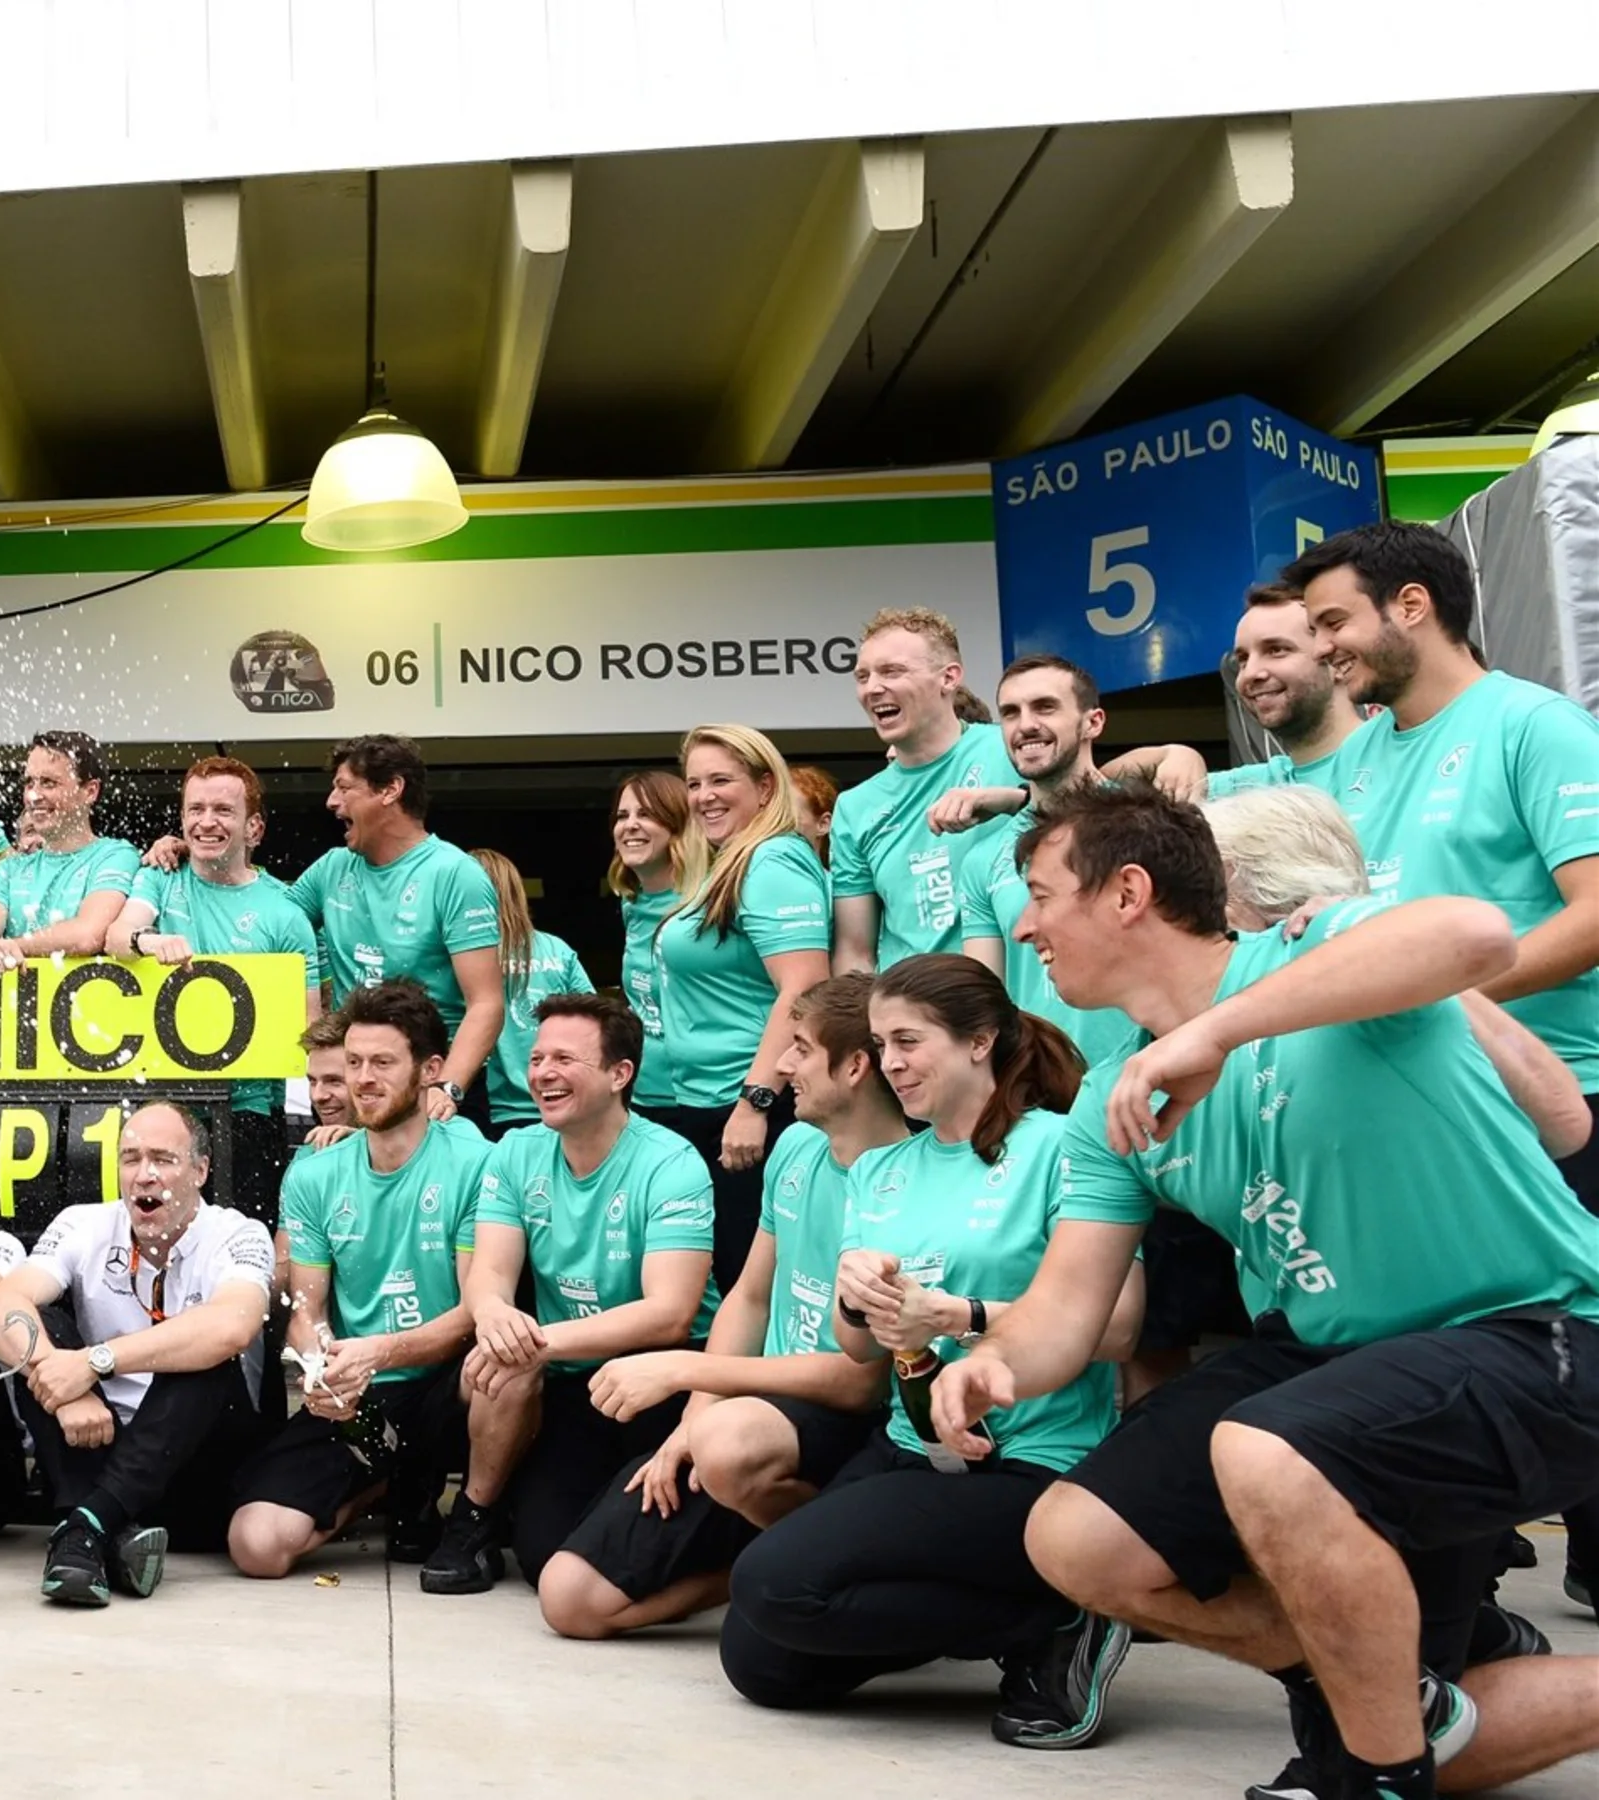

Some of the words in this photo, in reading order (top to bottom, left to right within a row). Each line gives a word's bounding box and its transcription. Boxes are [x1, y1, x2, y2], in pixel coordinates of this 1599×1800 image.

[1007, 461, 1079, 506] SÃO
[1104, 418, 1233, 480] PAULO
[1250, 415, 1288, 461] SÃO
[1299, 439, 1360, 491] PAULO
[1086, 525, 1157, 637] 5
[366, 650, 419, 686] 06
[459, 644, 583, 684] NICO
[601, 636, 857, 681] ROSBERG
[385, 1269, 415, 1282] ACE
[791, 1269, 832, 1293] RACE
[394, 1295, 423, 1328] 20
